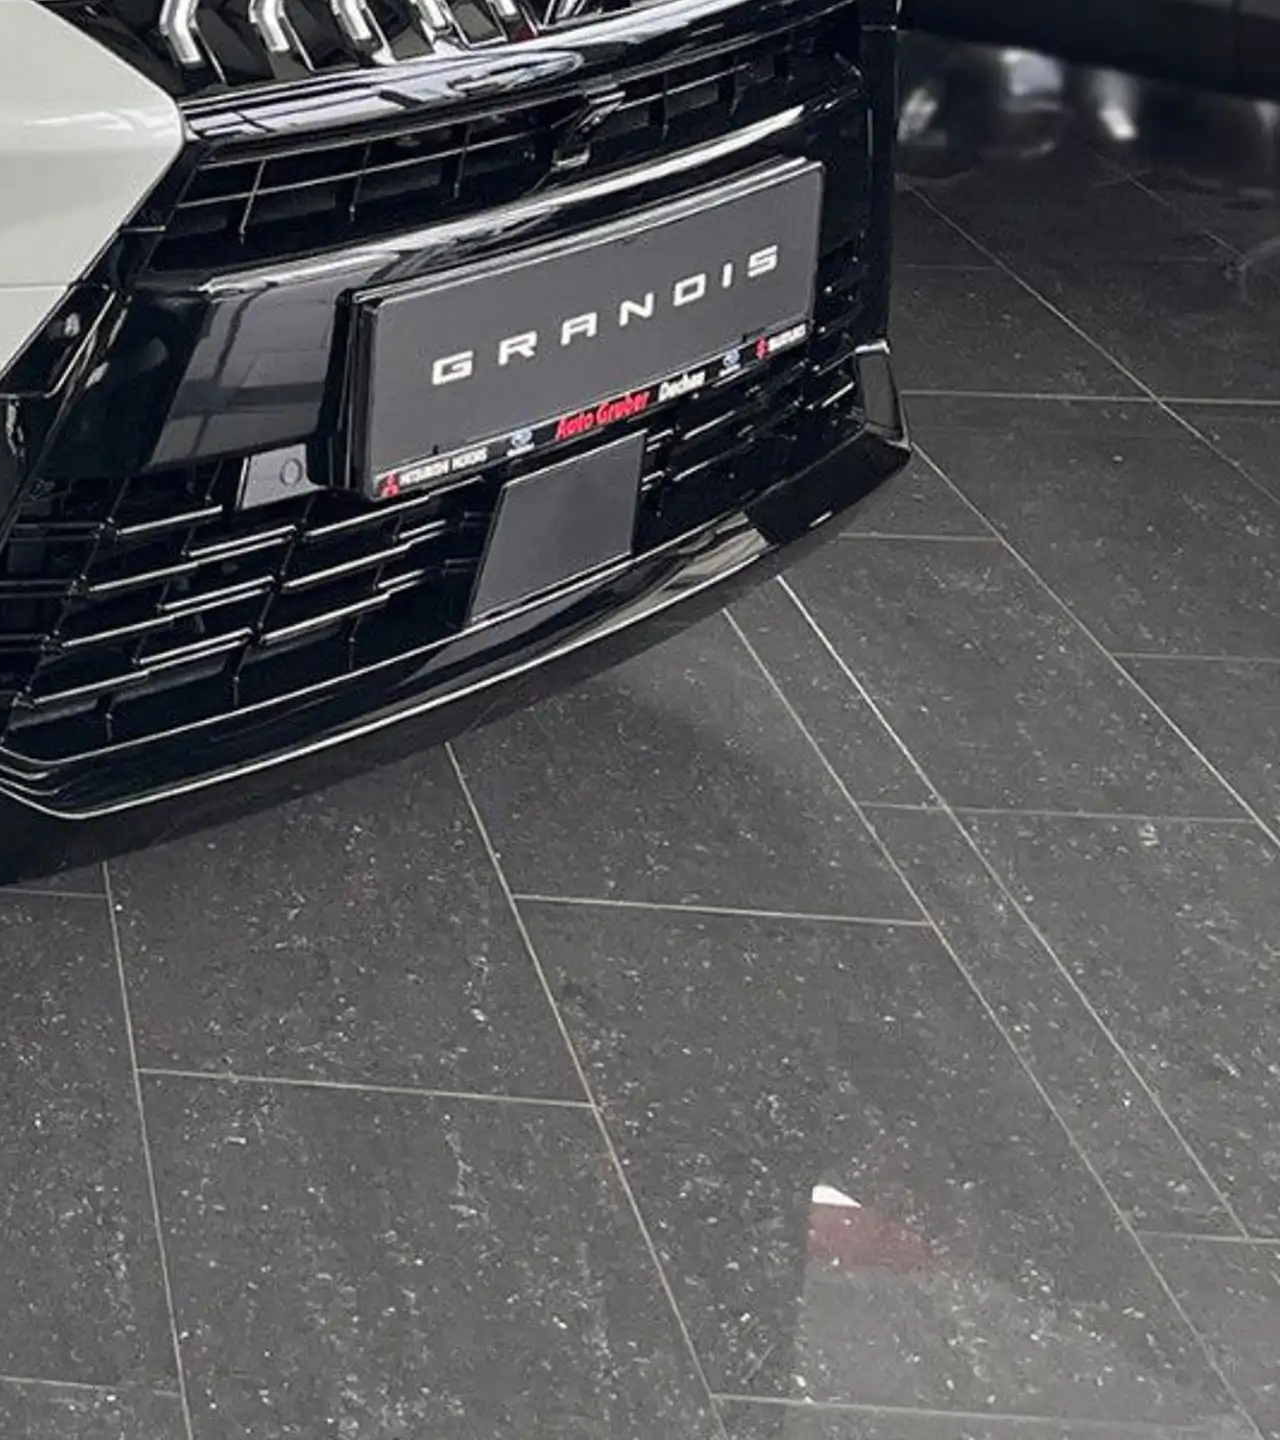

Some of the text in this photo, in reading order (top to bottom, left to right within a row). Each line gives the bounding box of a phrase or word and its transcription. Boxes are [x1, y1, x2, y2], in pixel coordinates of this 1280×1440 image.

[432, 244, 779, 385] GRANDIS
[554, 409, 595, 442] Auto
[596, 390, 651, 426] Gruber
